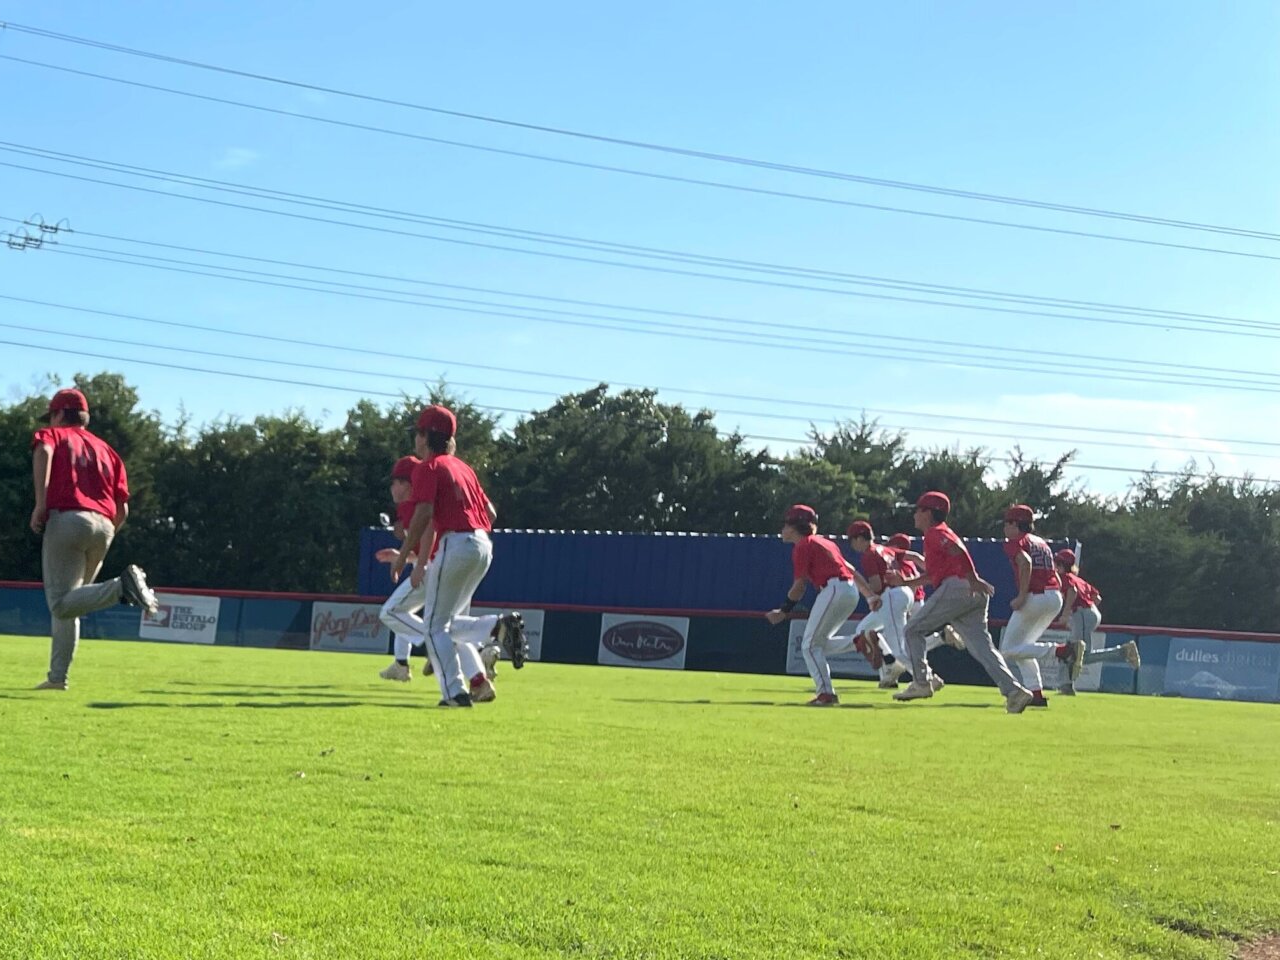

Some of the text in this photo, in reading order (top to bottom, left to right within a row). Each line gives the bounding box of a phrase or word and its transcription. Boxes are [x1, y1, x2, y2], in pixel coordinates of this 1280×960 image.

[174, 606, 193, 615] THE
[173, 613, 216, 624] BUFFALO
[351, 607, 381, 638] Day
[172, 622, 207, 632] GROUP
[1176, 647, 1219, 663] dulles
